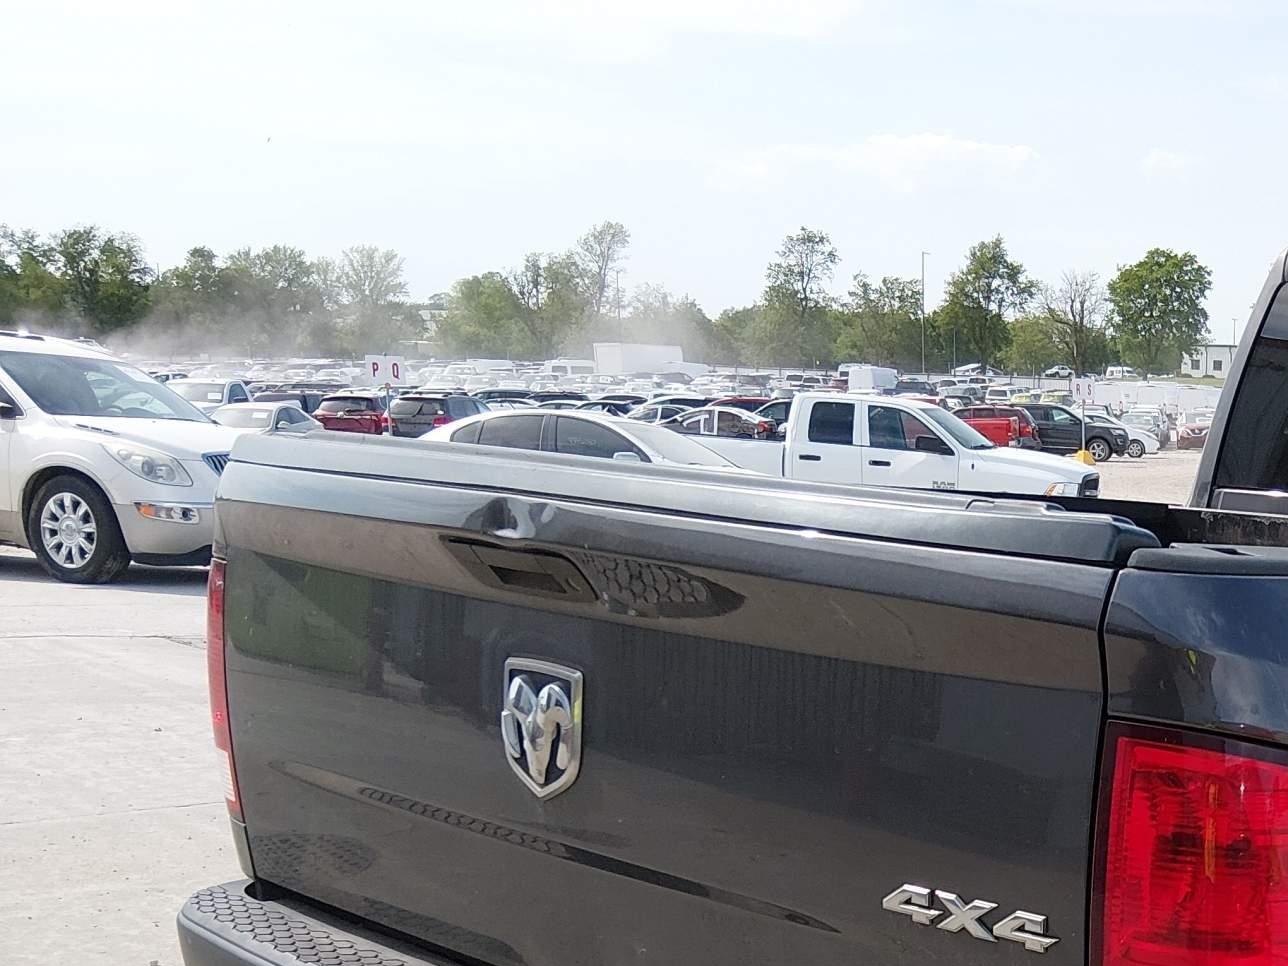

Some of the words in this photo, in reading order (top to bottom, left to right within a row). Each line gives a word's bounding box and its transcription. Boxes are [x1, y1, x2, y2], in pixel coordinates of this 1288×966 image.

[372, 362, 379, 377] P
[392, 363, 400, 379] Q
[1075, 383, 1081, 396] R
[1087, 383, 1092, 396] S
